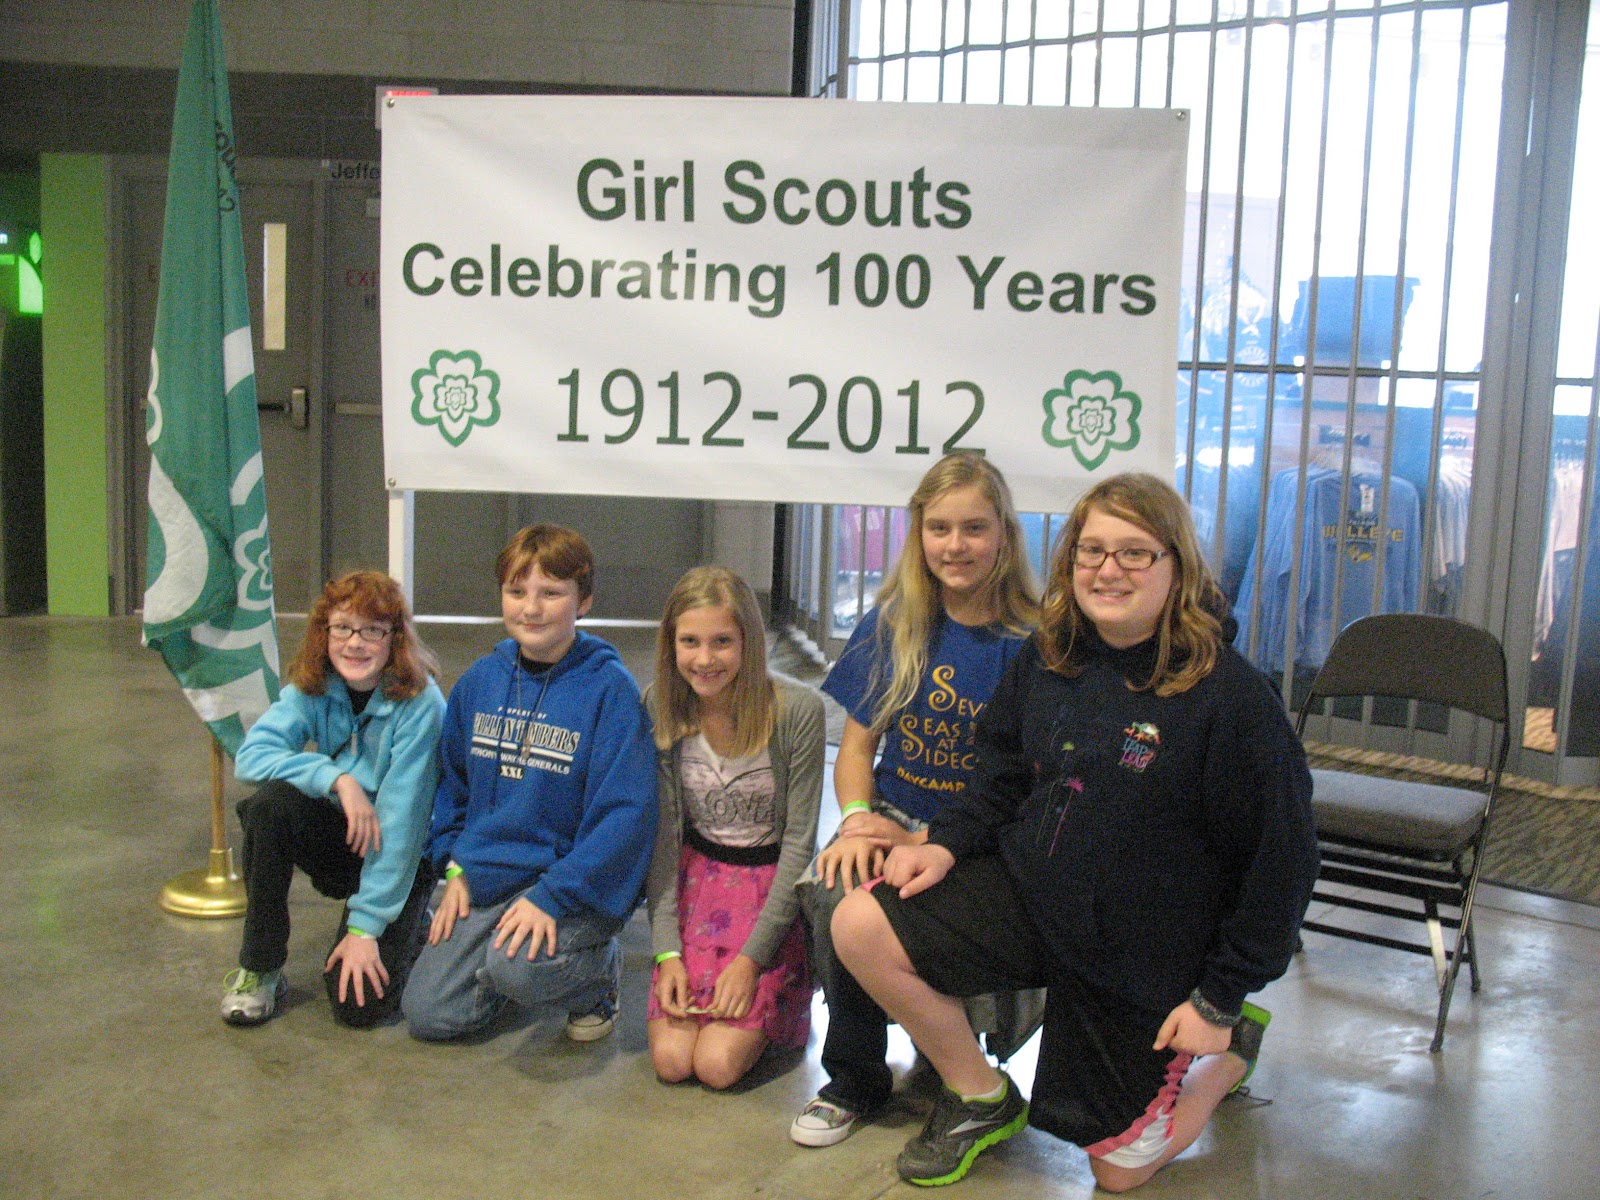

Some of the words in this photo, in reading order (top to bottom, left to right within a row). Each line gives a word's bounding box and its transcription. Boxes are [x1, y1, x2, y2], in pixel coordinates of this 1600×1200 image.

[576, 159, 695, 222] Girl
[723, 160, 972, 229] Scouts
[402, 243, 786, 318] Celebrating
[816, 252, 931, 309] 100
[958, 255, 1157, 317] Years
[556, 369, 986, 457] 1912-2012
[501, 765, 524, 780] XXL
